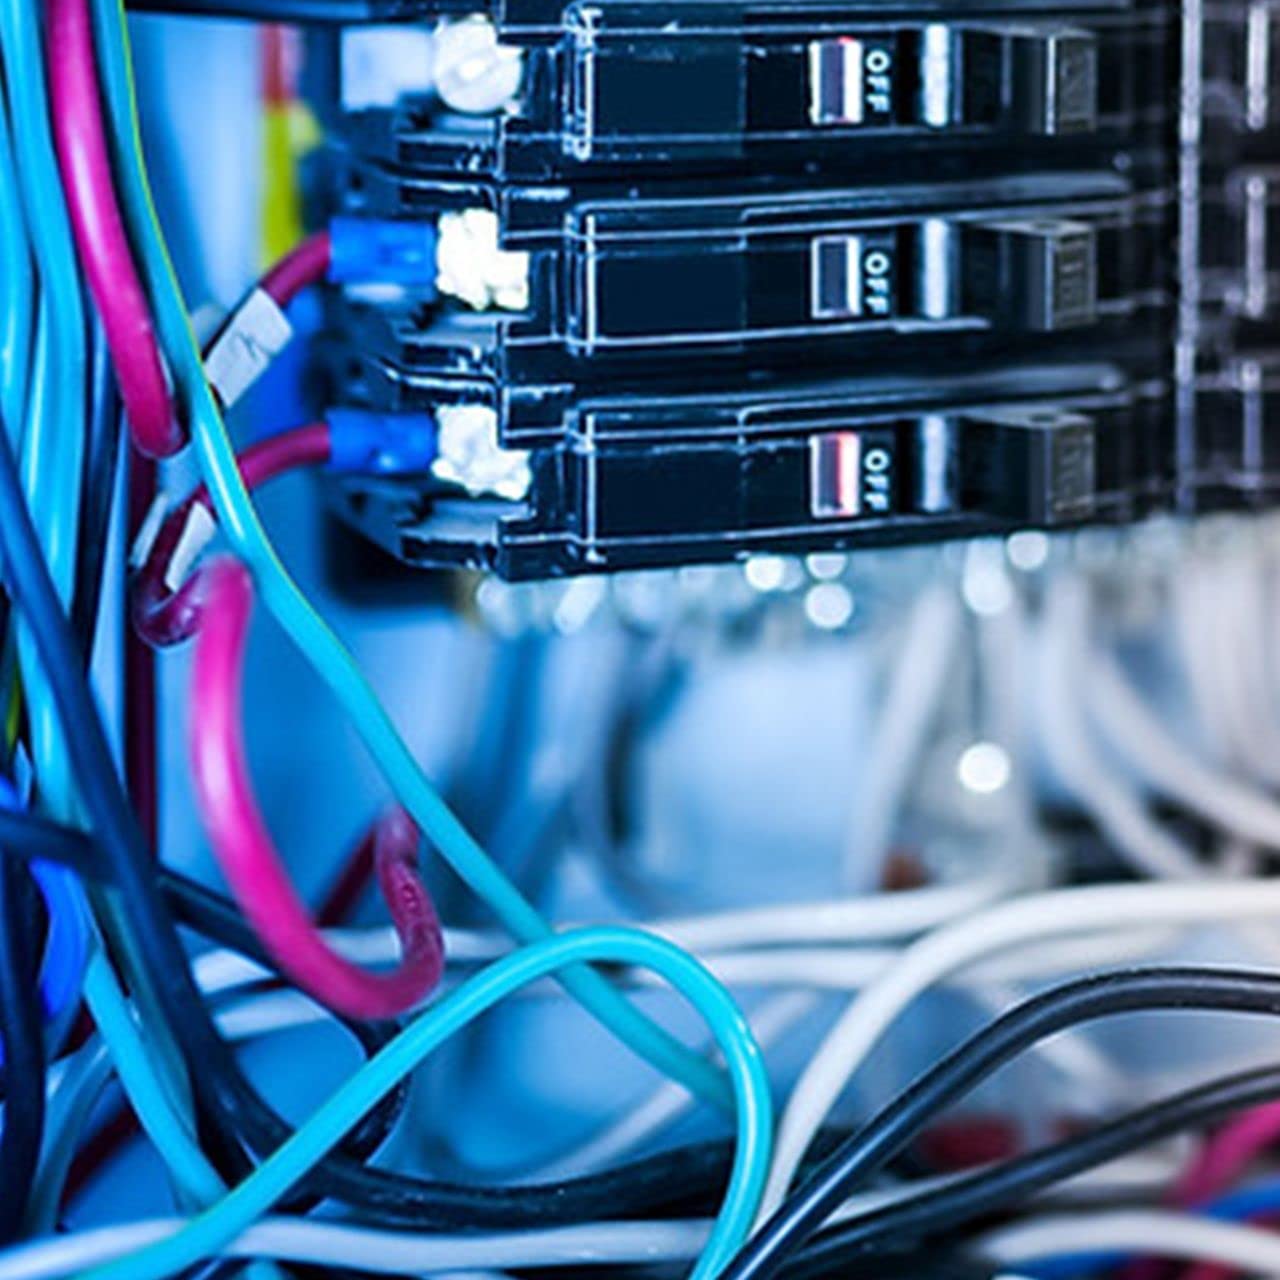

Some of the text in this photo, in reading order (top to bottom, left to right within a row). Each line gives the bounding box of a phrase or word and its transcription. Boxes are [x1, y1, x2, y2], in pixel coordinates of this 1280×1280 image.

[865, 49, 891, 111] OFF
[864, 252, 890, 313] OFF
[864, 449, 889, 510] OFF
